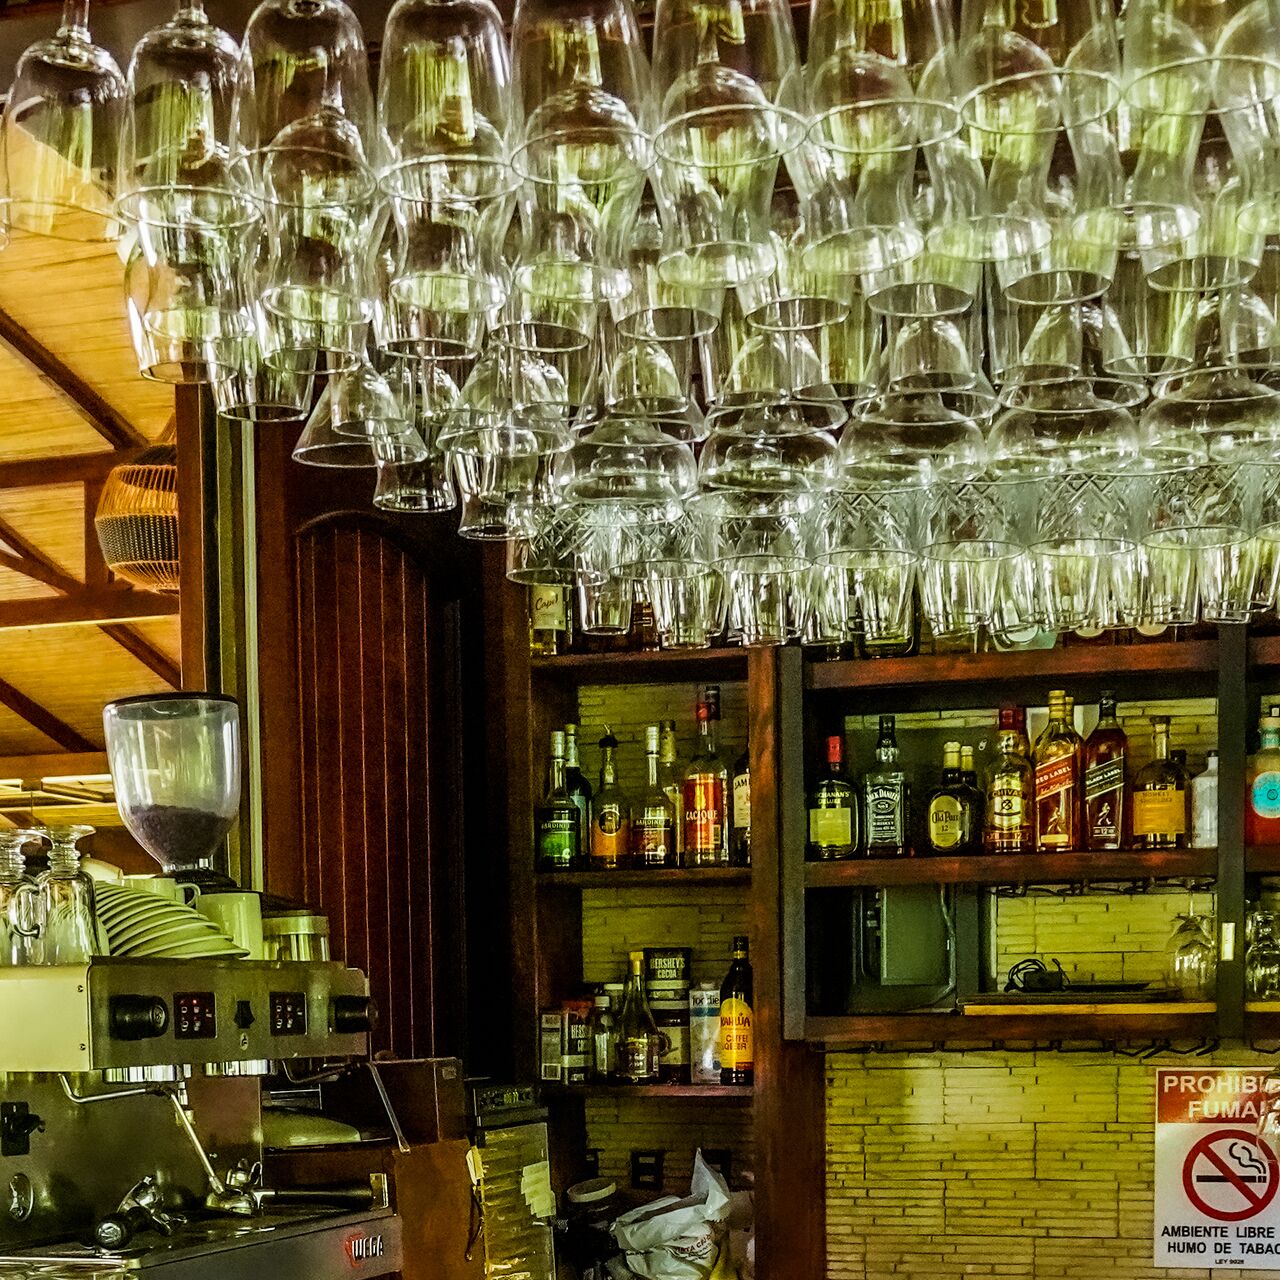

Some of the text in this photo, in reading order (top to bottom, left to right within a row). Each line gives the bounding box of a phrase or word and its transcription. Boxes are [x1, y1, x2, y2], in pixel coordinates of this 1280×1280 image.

[1049, 766, 1072, 779] LABEL
[1161, 1225, 1229, 1238] AMBIENTE
[1236, 1226, 1276, 1239] LIBRE
[351, 1234, 384, 1261] WEGA
[1167, 1241, 1207, 1254] HUMO
[1214, 1242, 1232, 1254] DE
